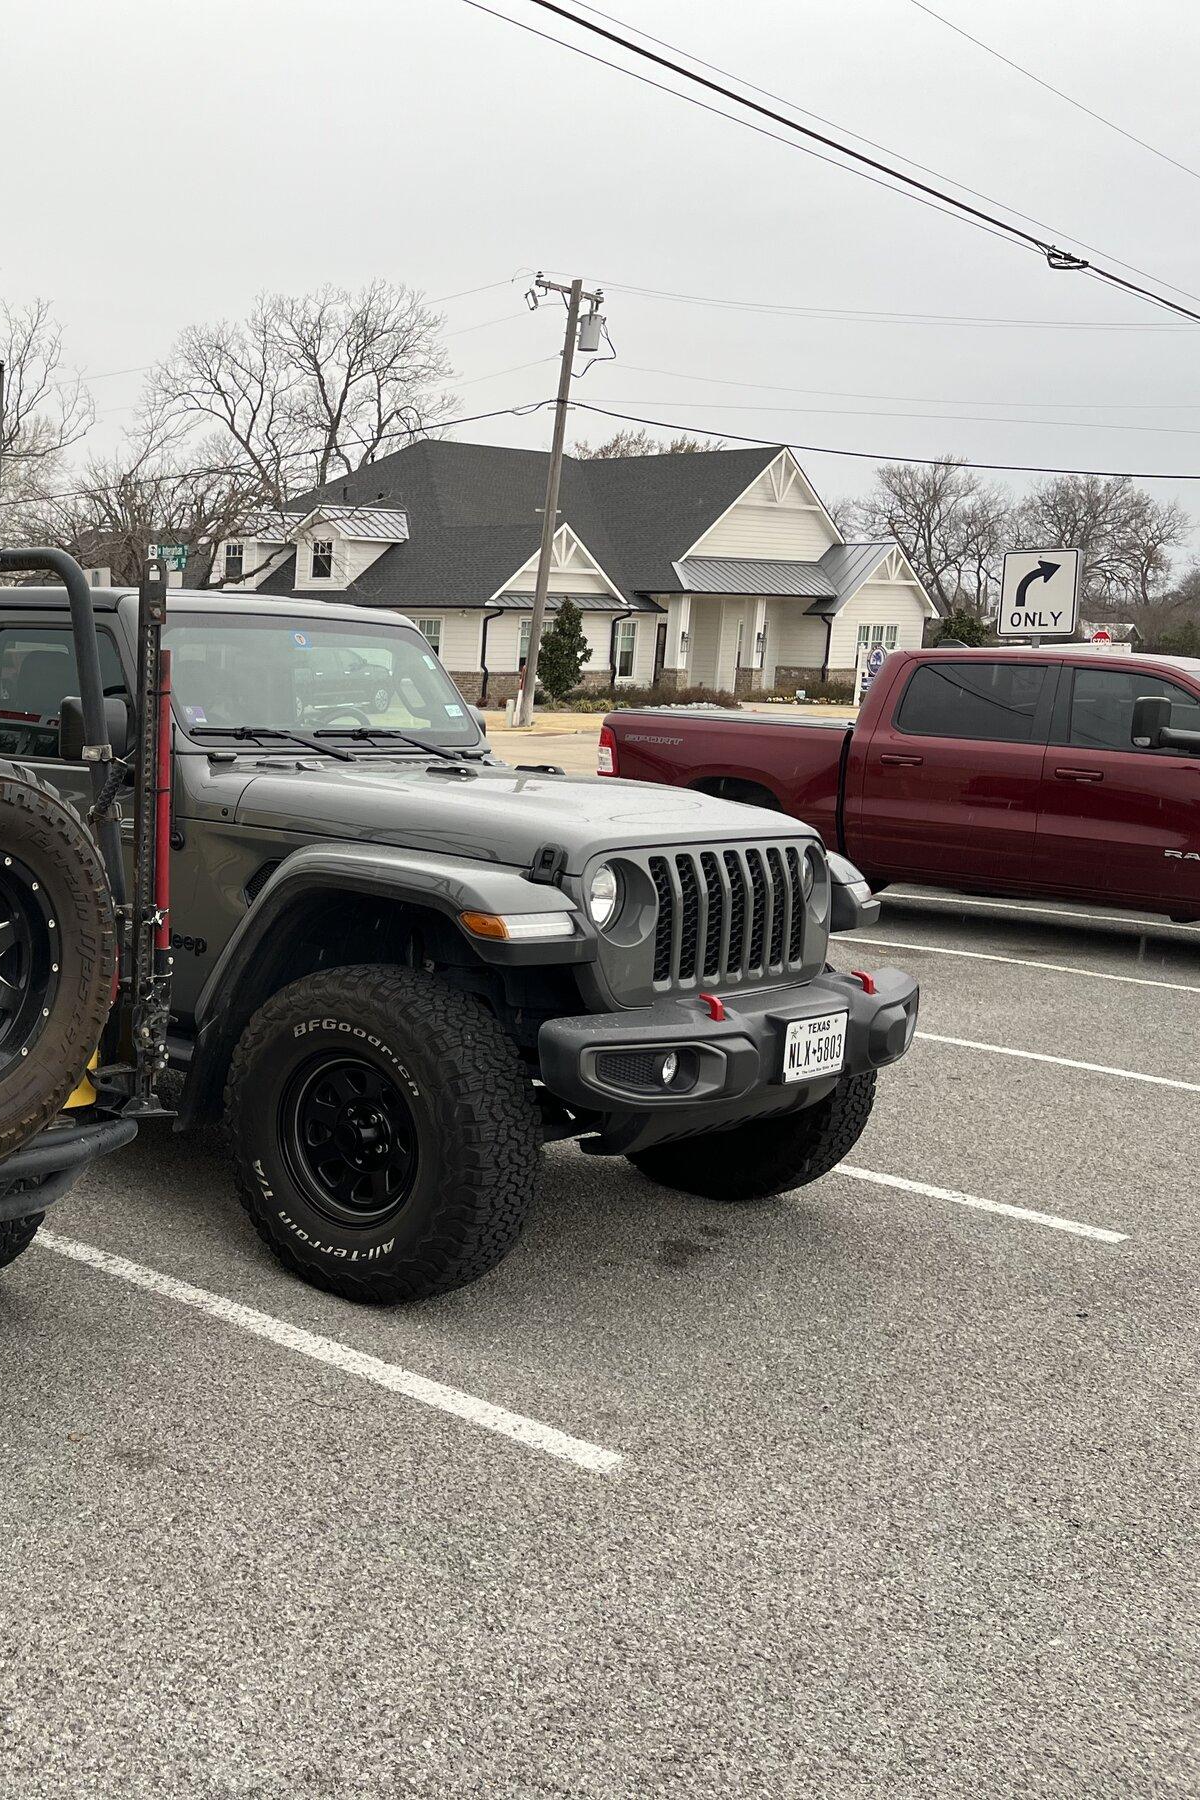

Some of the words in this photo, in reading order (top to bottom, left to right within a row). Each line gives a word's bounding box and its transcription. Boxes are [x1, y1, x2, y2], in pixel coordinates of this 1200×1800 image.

[1010, 611, 1063, 628] ONLY
[625, 734, 683, 745] SPORT
[169, 928, 207, 957] eep
[808, 1020, 830, 1034] TEXAS
[294, 1018, 420, 1097] BFGoodrich
[253, 1159, 274, 1201] T/A
[278, 1211, 396, 1262] All-Terrain
